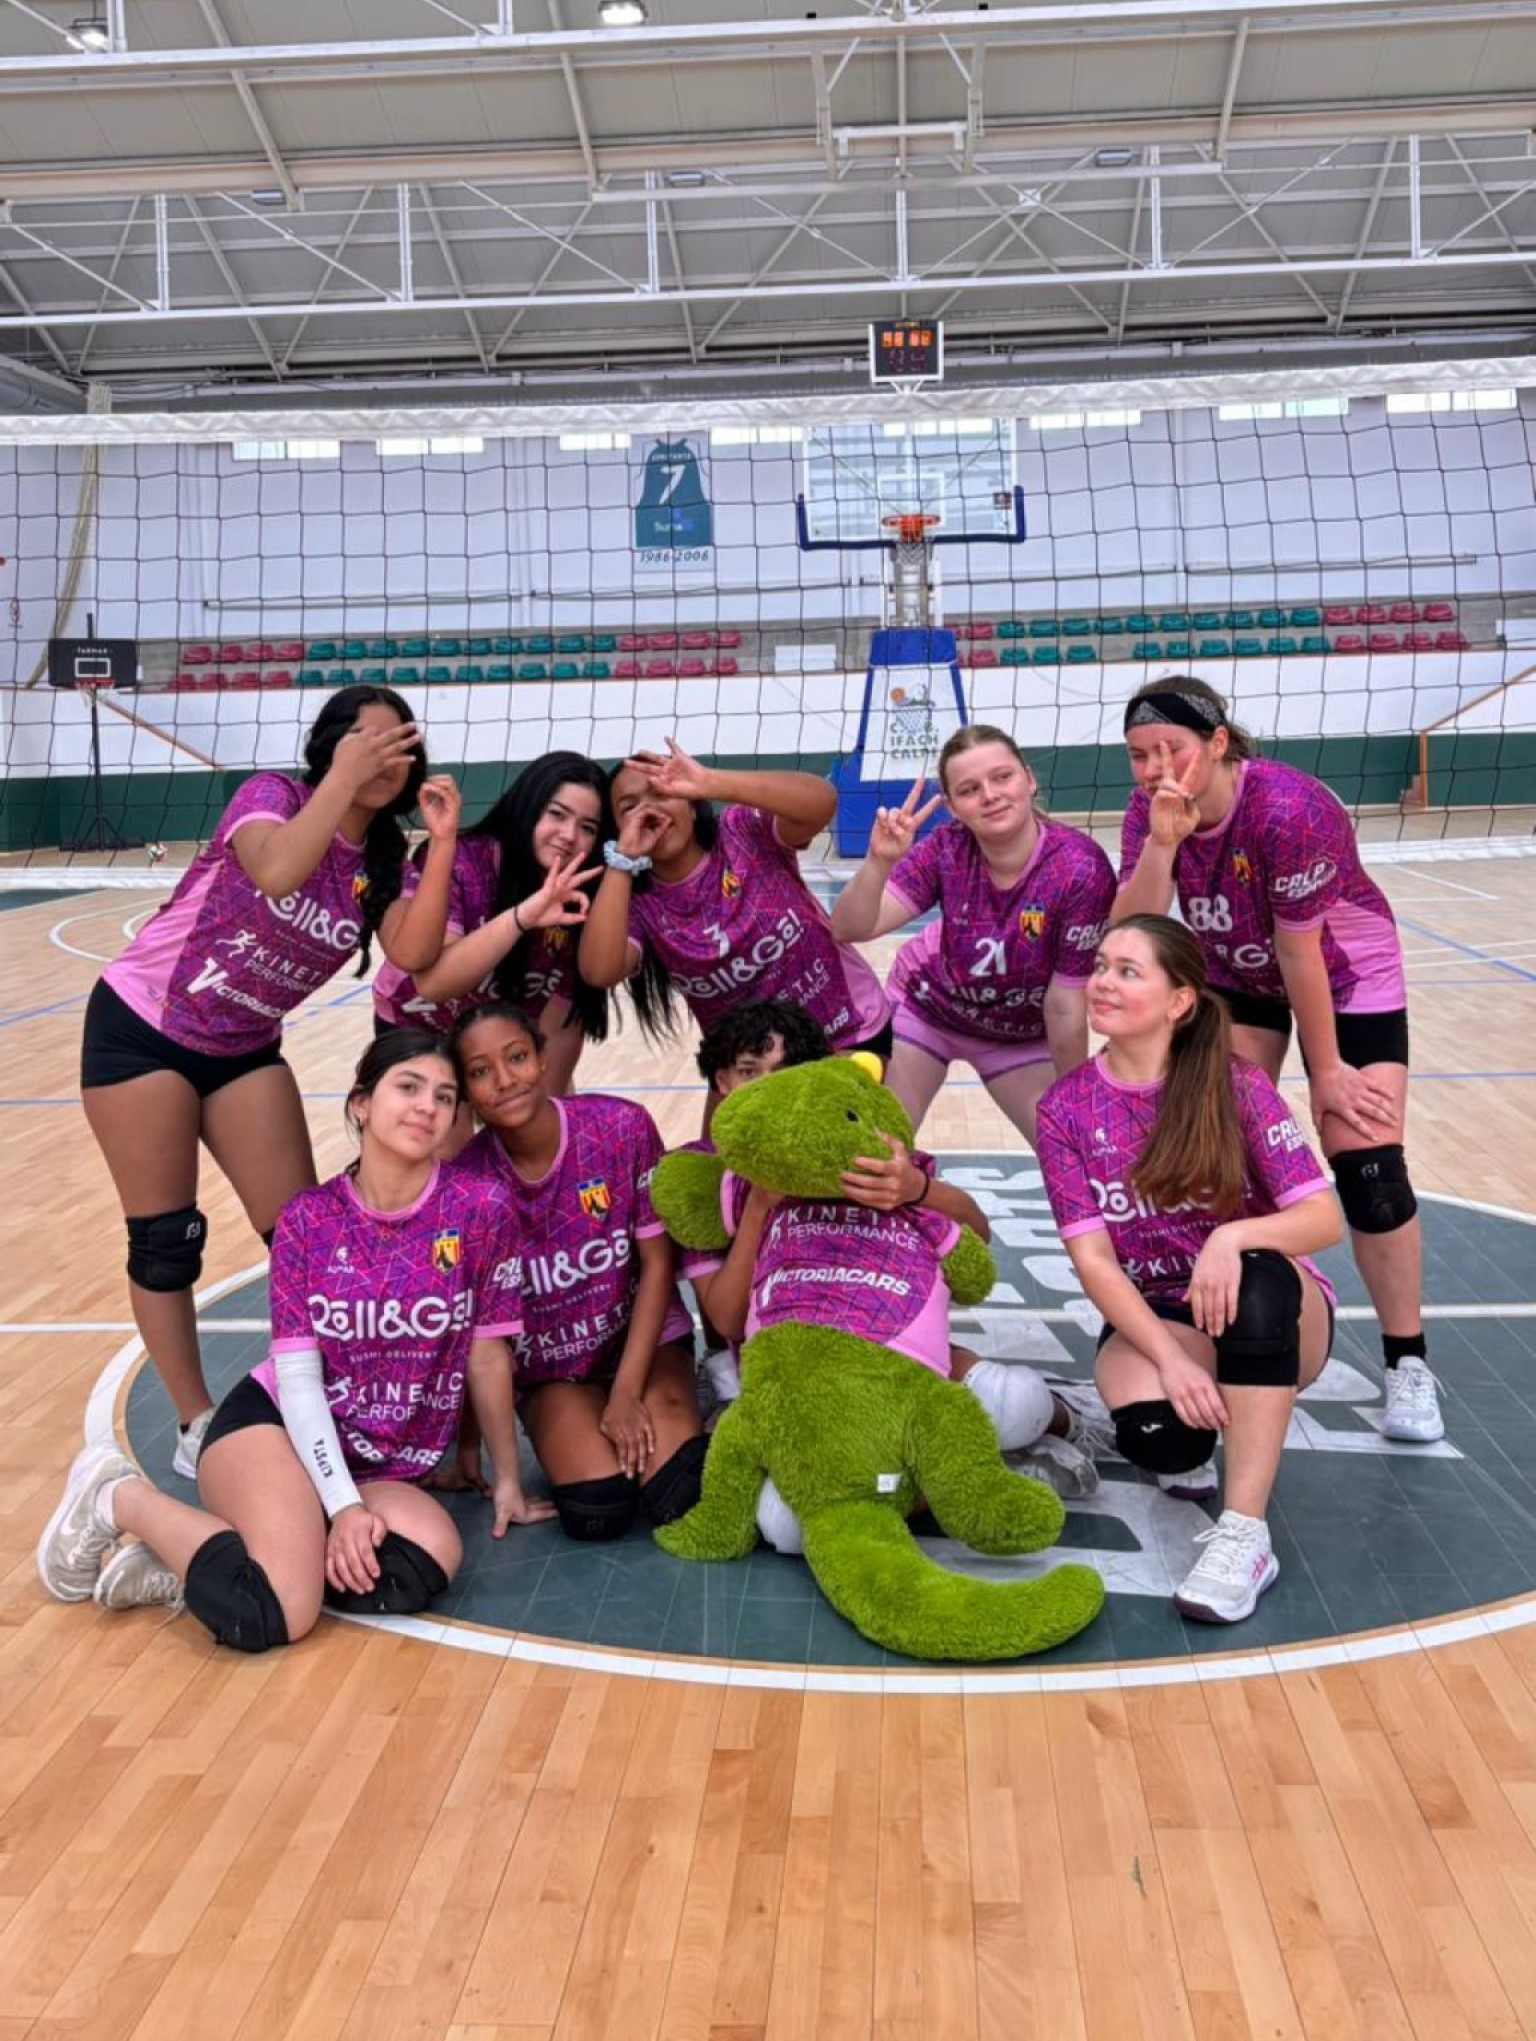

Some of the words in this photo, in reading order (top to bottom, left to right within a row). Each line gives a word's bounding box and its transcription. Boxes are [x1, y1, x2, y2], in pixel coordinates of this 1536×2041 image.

[659, 464, 685, 505] 7
[1188, 895, 1233, 932] 88
[787, 1222, 921, 1251] PERFORMANCE
